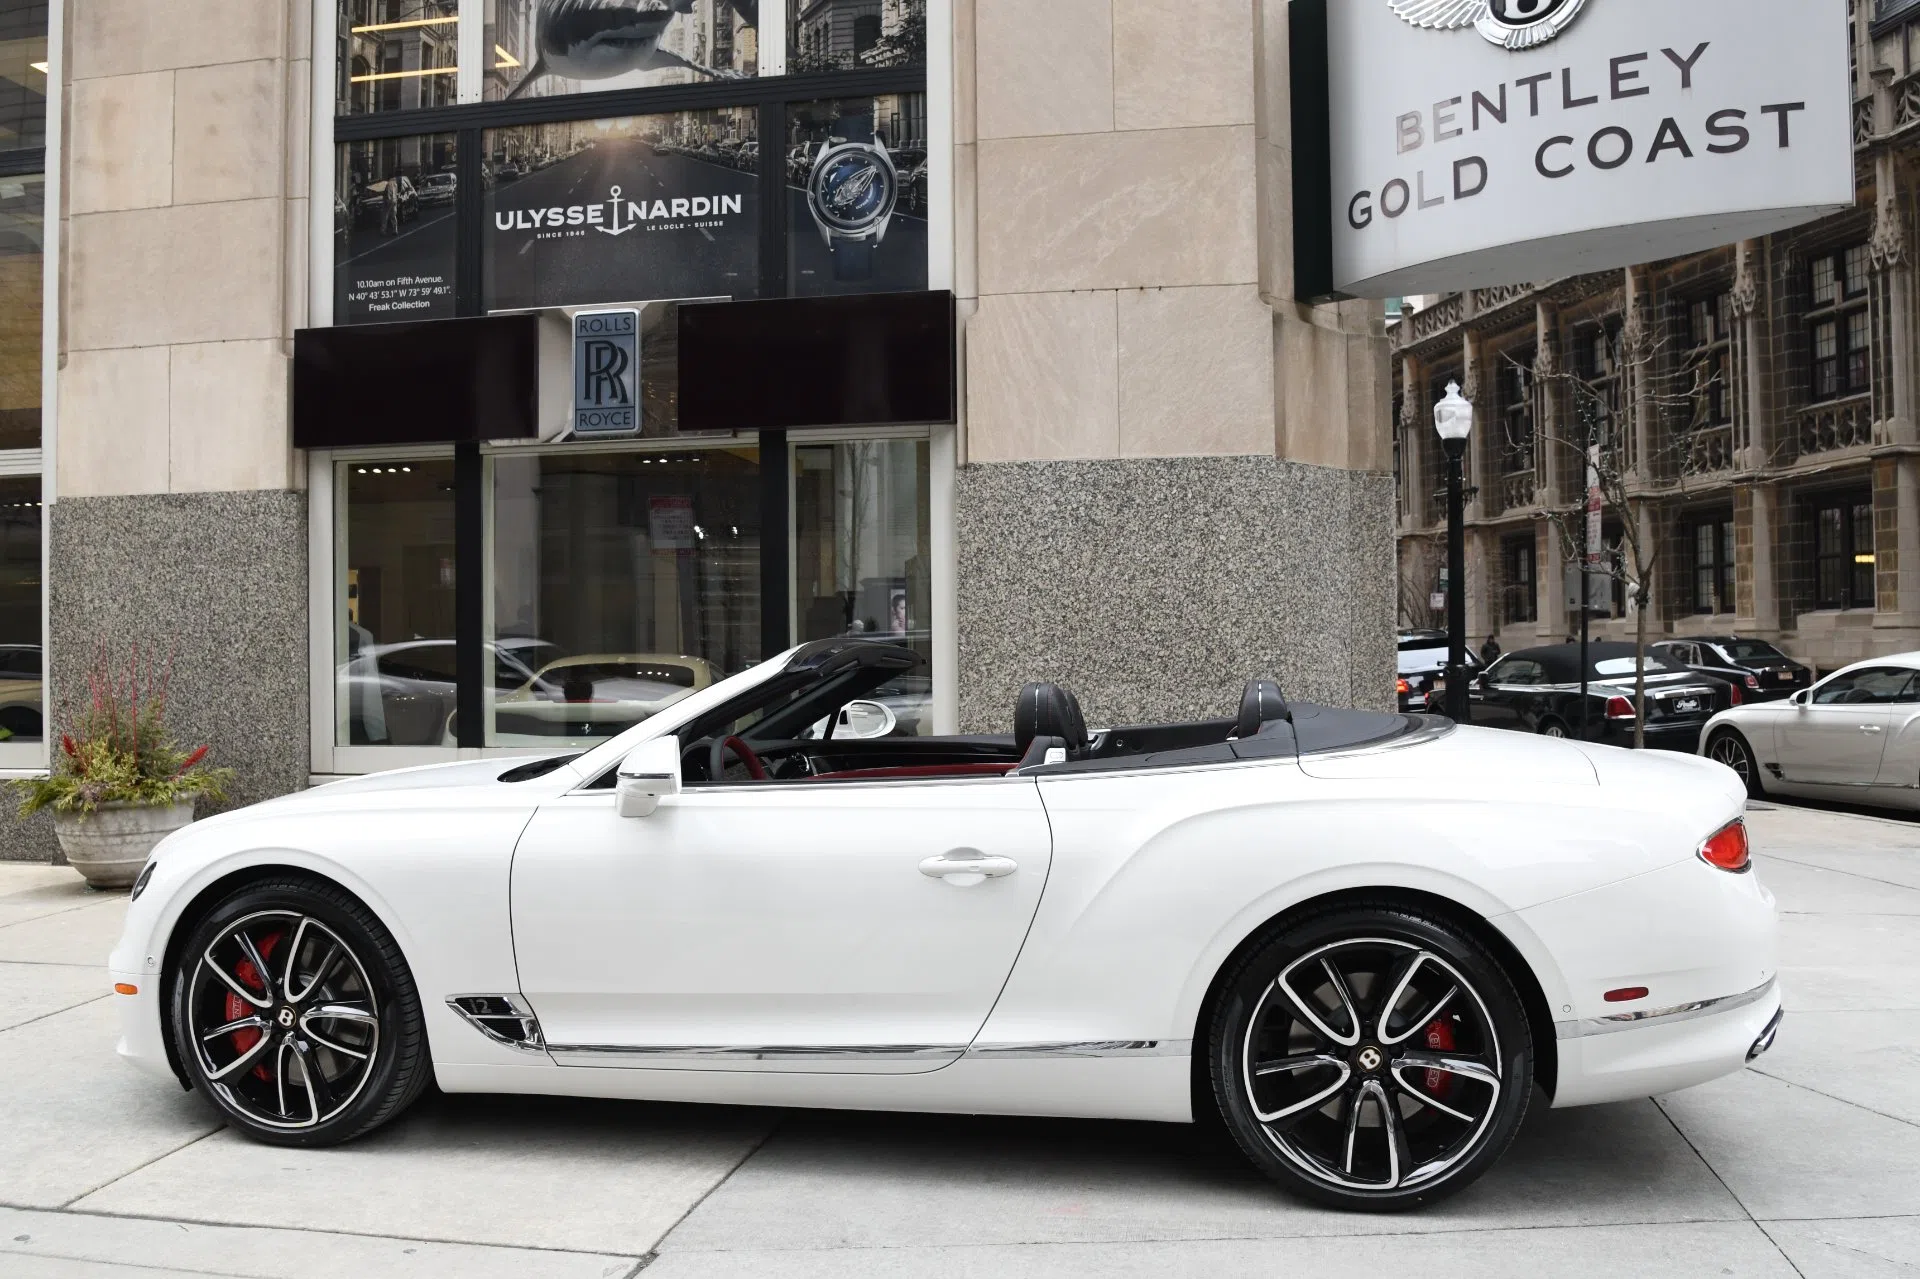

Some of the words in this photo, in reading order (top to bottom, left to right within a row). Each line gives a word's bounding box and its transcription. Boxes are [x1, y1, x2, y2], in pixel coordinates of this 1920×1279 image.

[1396, 42, 1711, 155] BENTLEY
[1347, 155, 1488, 230] GOLD
[1534, 101, 1805, 178] COAST
[495, 203, 604, 231] ULYSSE
[627, 194, 742, 221] NARDIN
[694, 220, 724, 228] SUISSE
[537, 231, 562, 239] SINCE
[356, 280, 385, 289] 10.10am
[397, 277, 413, 286] Fifth
[348, 293, 355, 301] N
[399, 289, 407, 298] W
[368, 303, 391, 312] Freak
[391, 300, 431, 310] Collection
[580, 317, 631, 333] ROLLS
[580, 411, 631, 426] ROYCE
